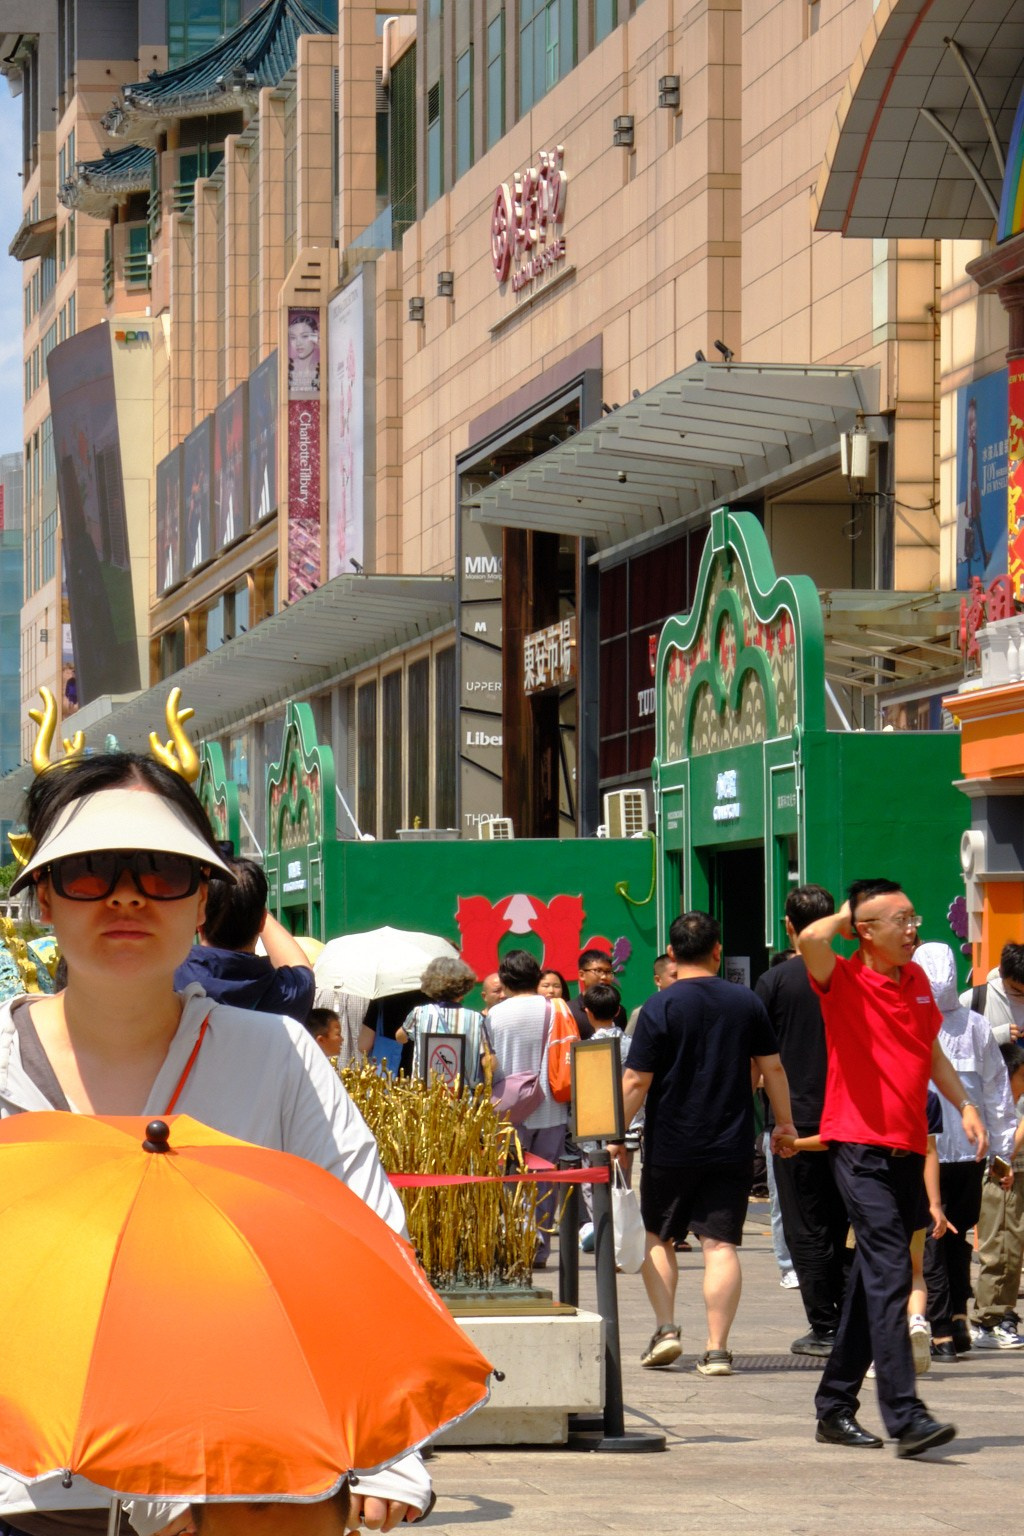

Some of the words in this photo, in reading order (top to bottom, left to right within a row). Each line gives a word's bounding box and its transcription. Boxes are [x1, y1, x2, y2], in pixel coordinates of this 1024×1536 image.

[115, 331, 150, 345] apm
[523, 618, 571, 690] 東安市場
